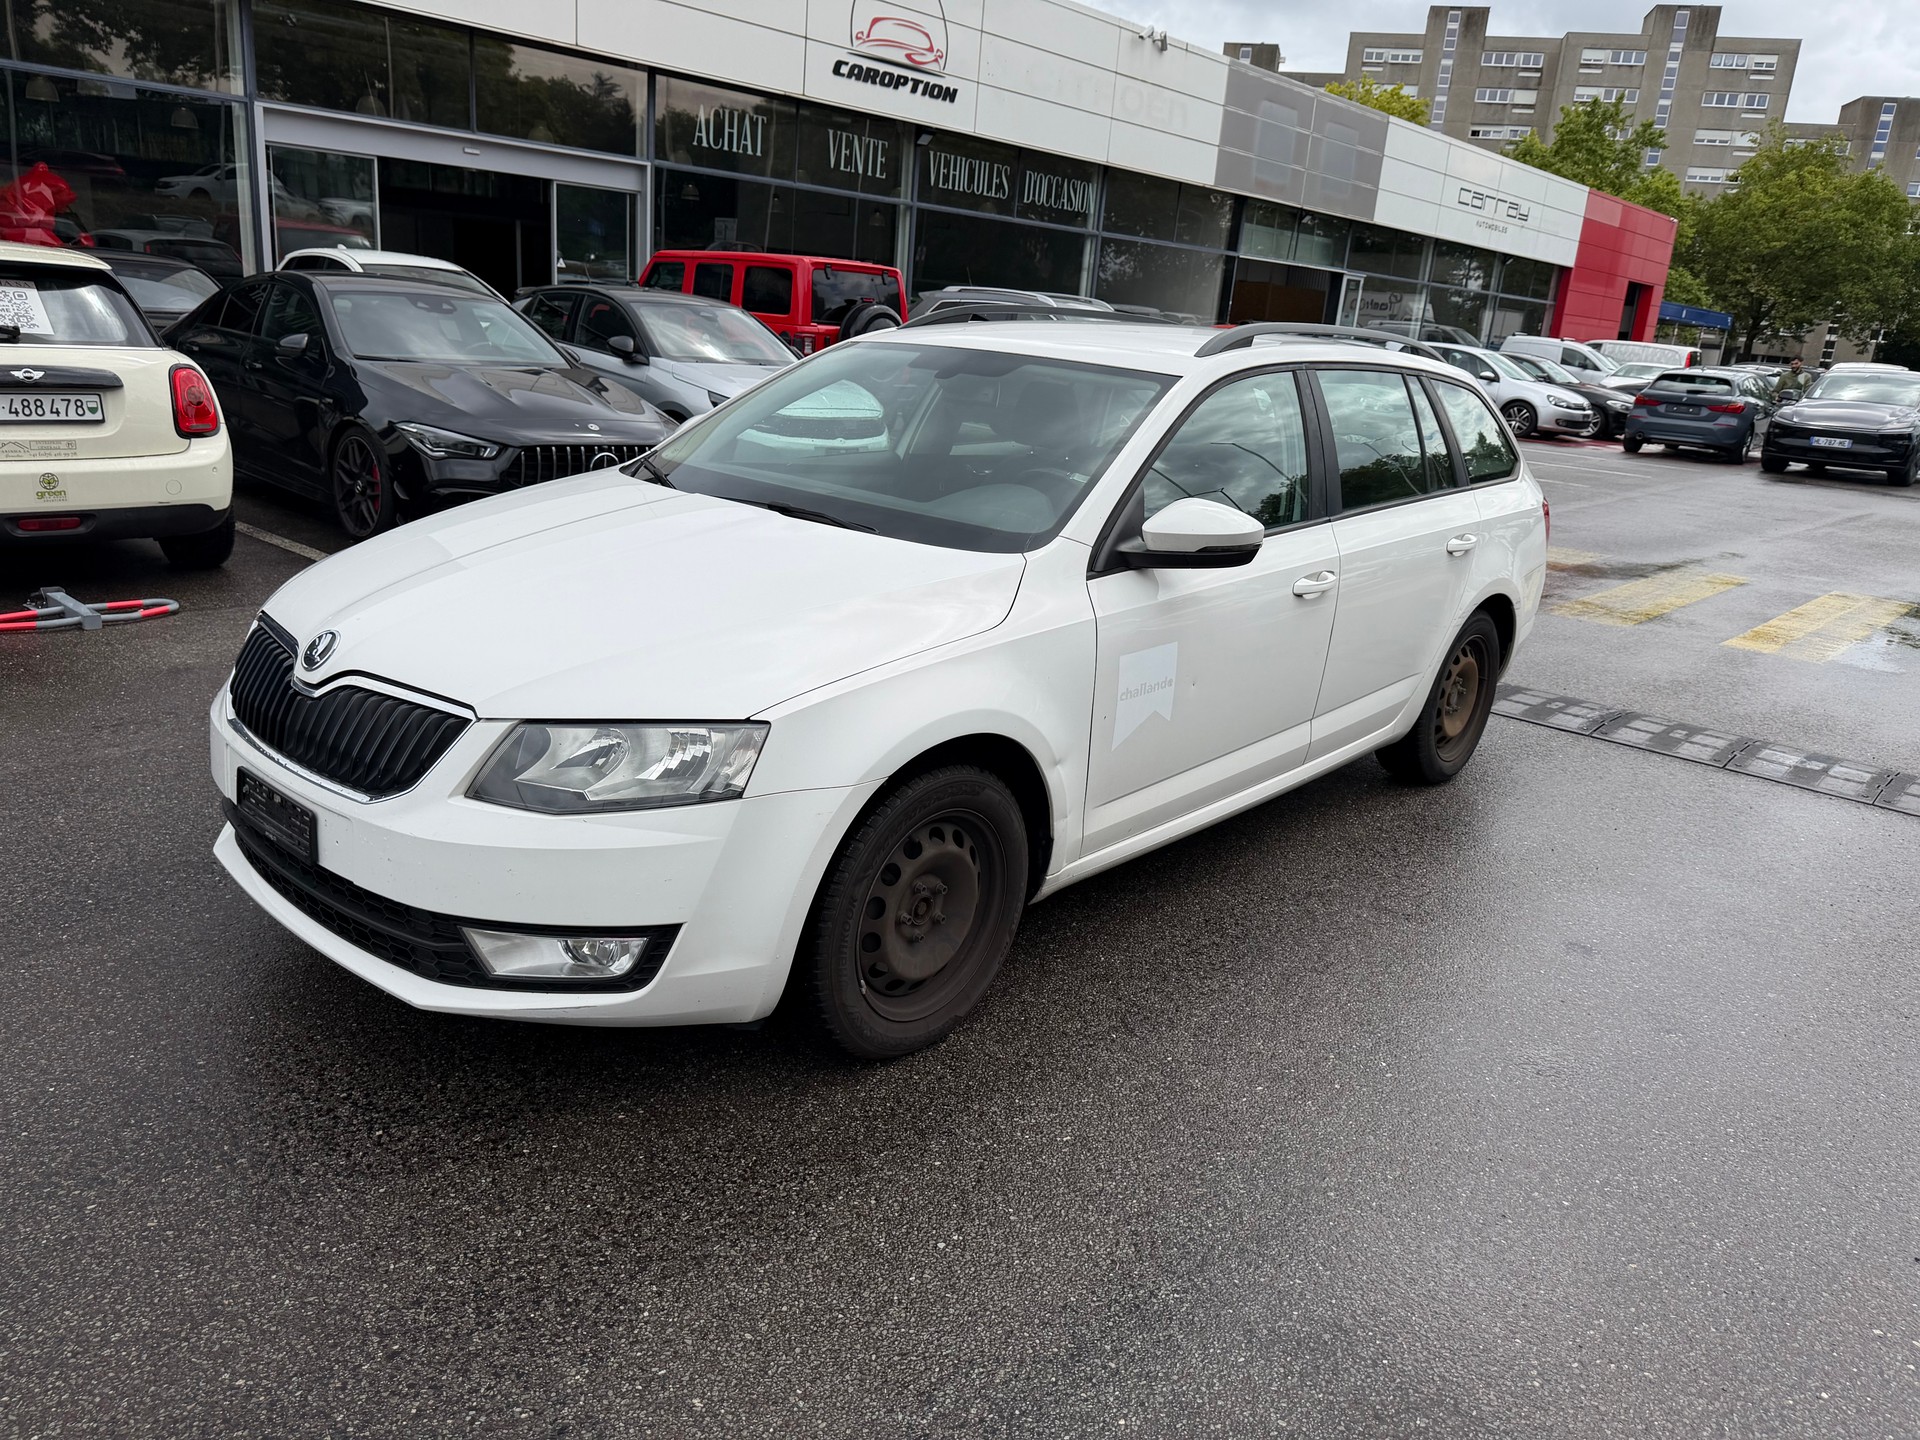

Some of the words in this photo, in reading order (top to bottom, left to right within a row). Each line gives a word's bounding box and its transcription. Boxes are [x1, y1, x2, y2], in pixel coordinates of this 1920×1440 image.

[832, 59, 958, 103] CAROPTION
[692, 104, 767, 157] ACHAT
[827, 128, 889, 179] VENTE
[929, 151, 1011, 200] VEHICULES
[1023, 169, 1097, 214] D'OCCASION
[1475, 219, 1508, 234] AUTOMOBILES
[36, 490, 66, 499] green
